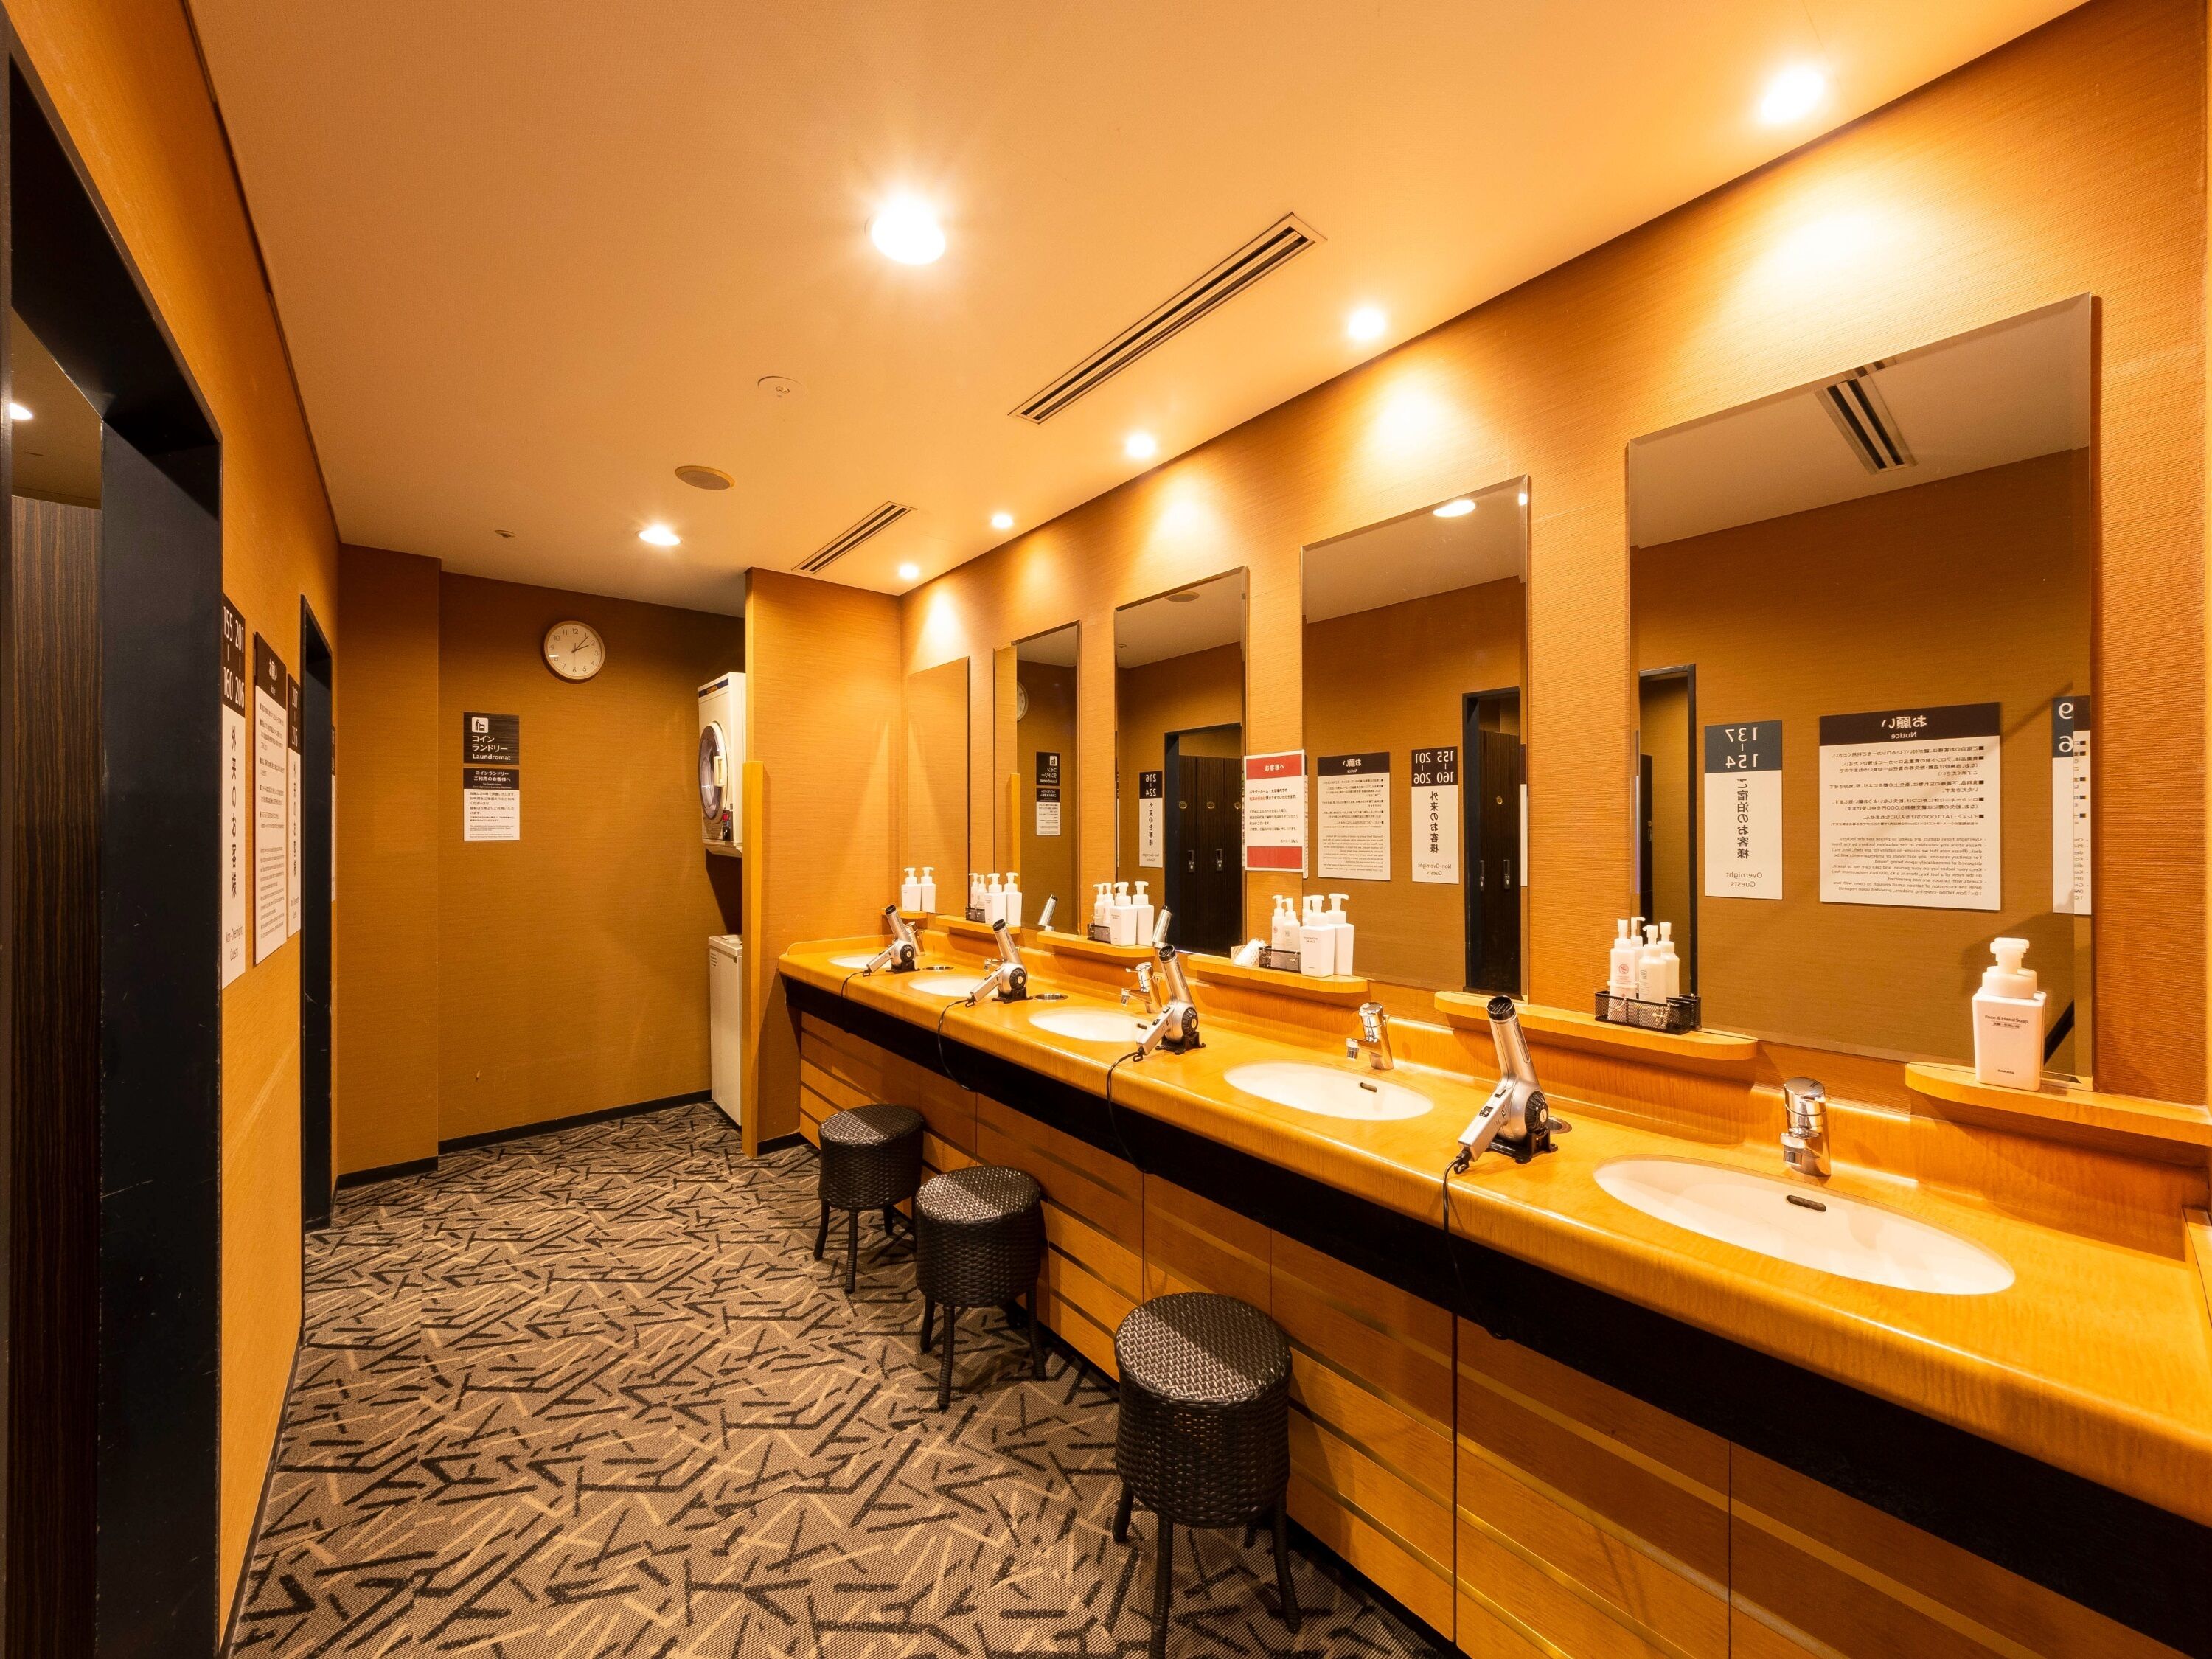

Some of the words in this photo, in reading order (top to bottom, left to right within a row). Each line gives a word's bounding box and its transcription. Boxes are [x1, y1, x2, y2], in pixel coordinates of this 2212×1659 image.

[223, 606, 233, 642] 155
[235, 619, 244, 653] 201
[223, 667, 233, 700] 160
[235, 676, 245, 709] 206
[472, 744, 508, 752] ランドリー
